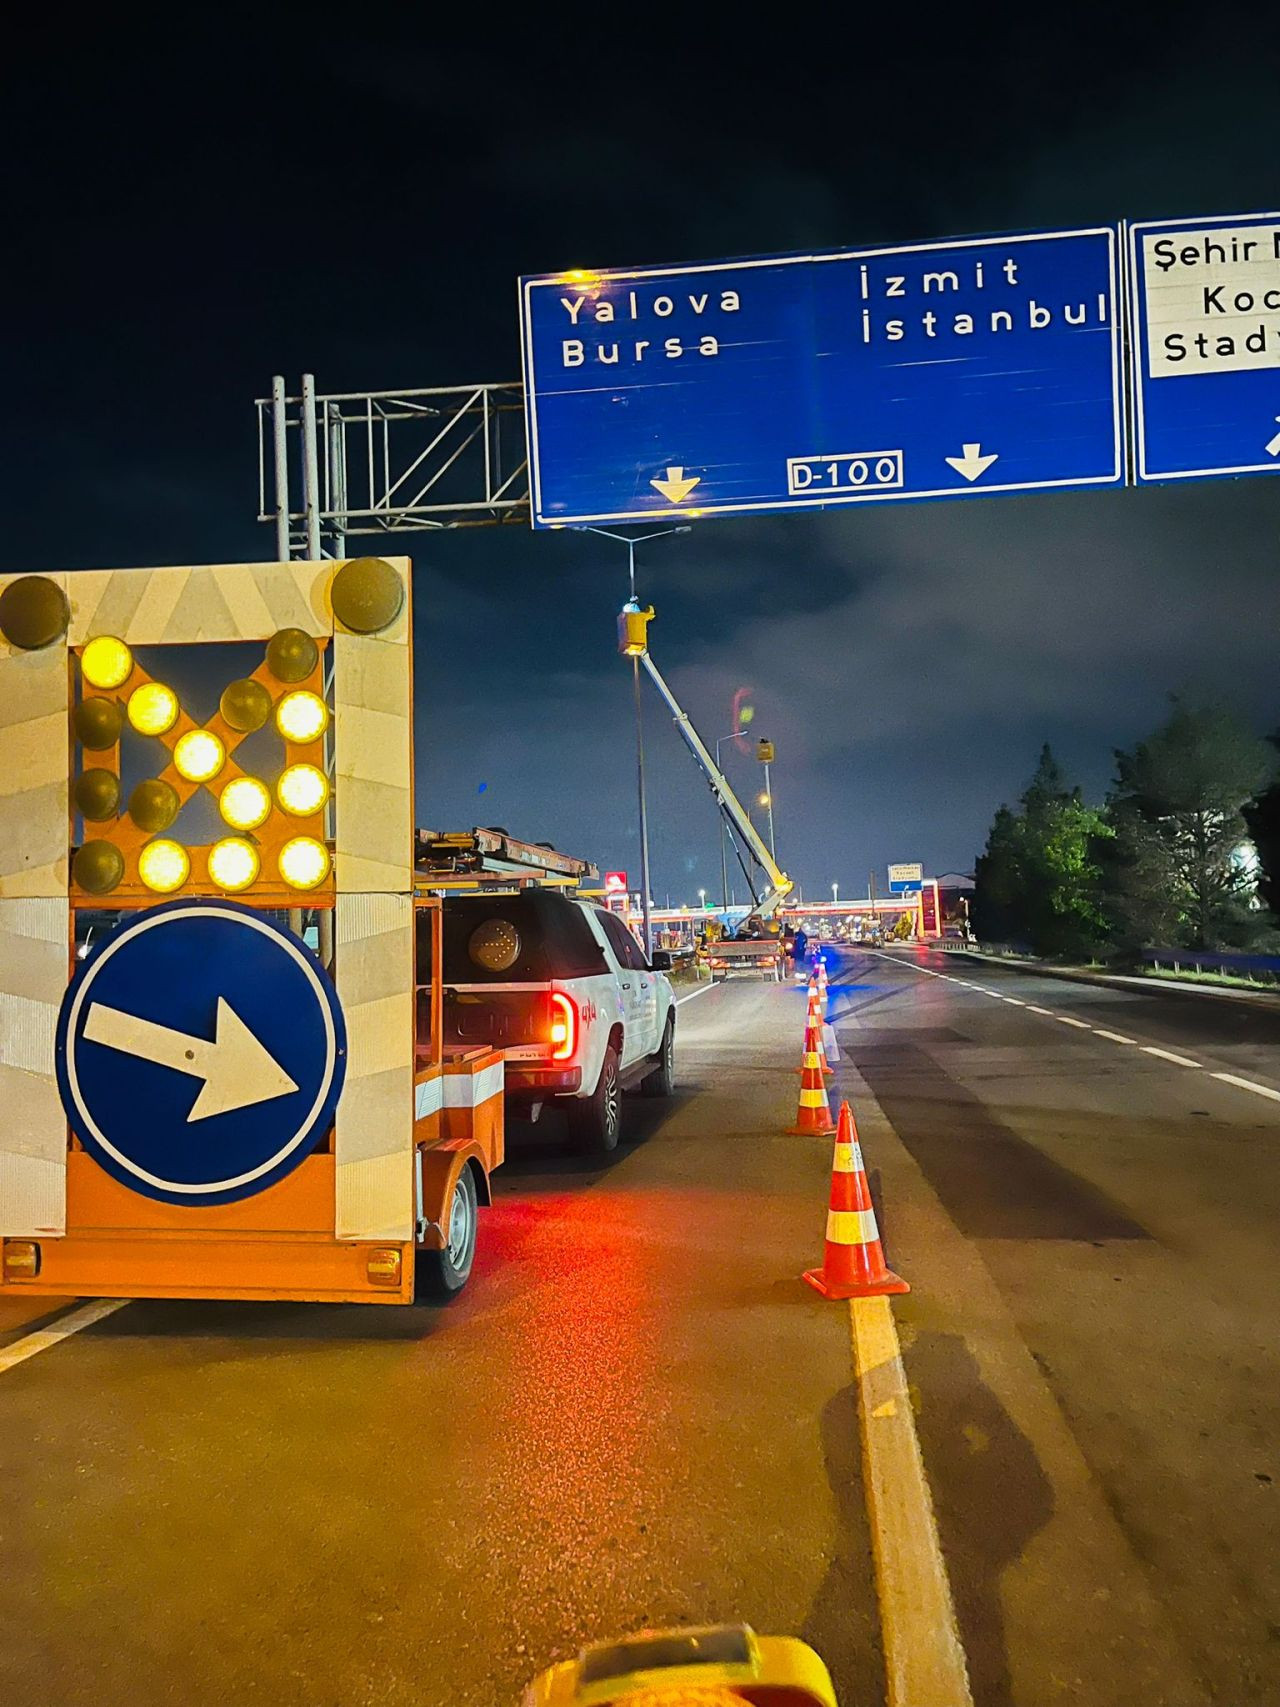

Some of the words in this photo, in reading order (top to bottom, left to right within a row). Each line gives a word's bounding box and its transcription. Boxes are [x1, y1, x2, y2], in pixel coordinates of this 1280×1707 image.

[1154, 237, 1258, 272] Şehir
[860, 259, 1018, 299] İzmit
[561, 290, 740, 324] Yalova
[1204, 286, 1280, 314] Koc
[862, 293, 1106, 343] İstanbul
[562, 335, 719, 367] Bursa
[1164, 325, 1280, 361] Stad
[793, 457, 896, 489] D-100
